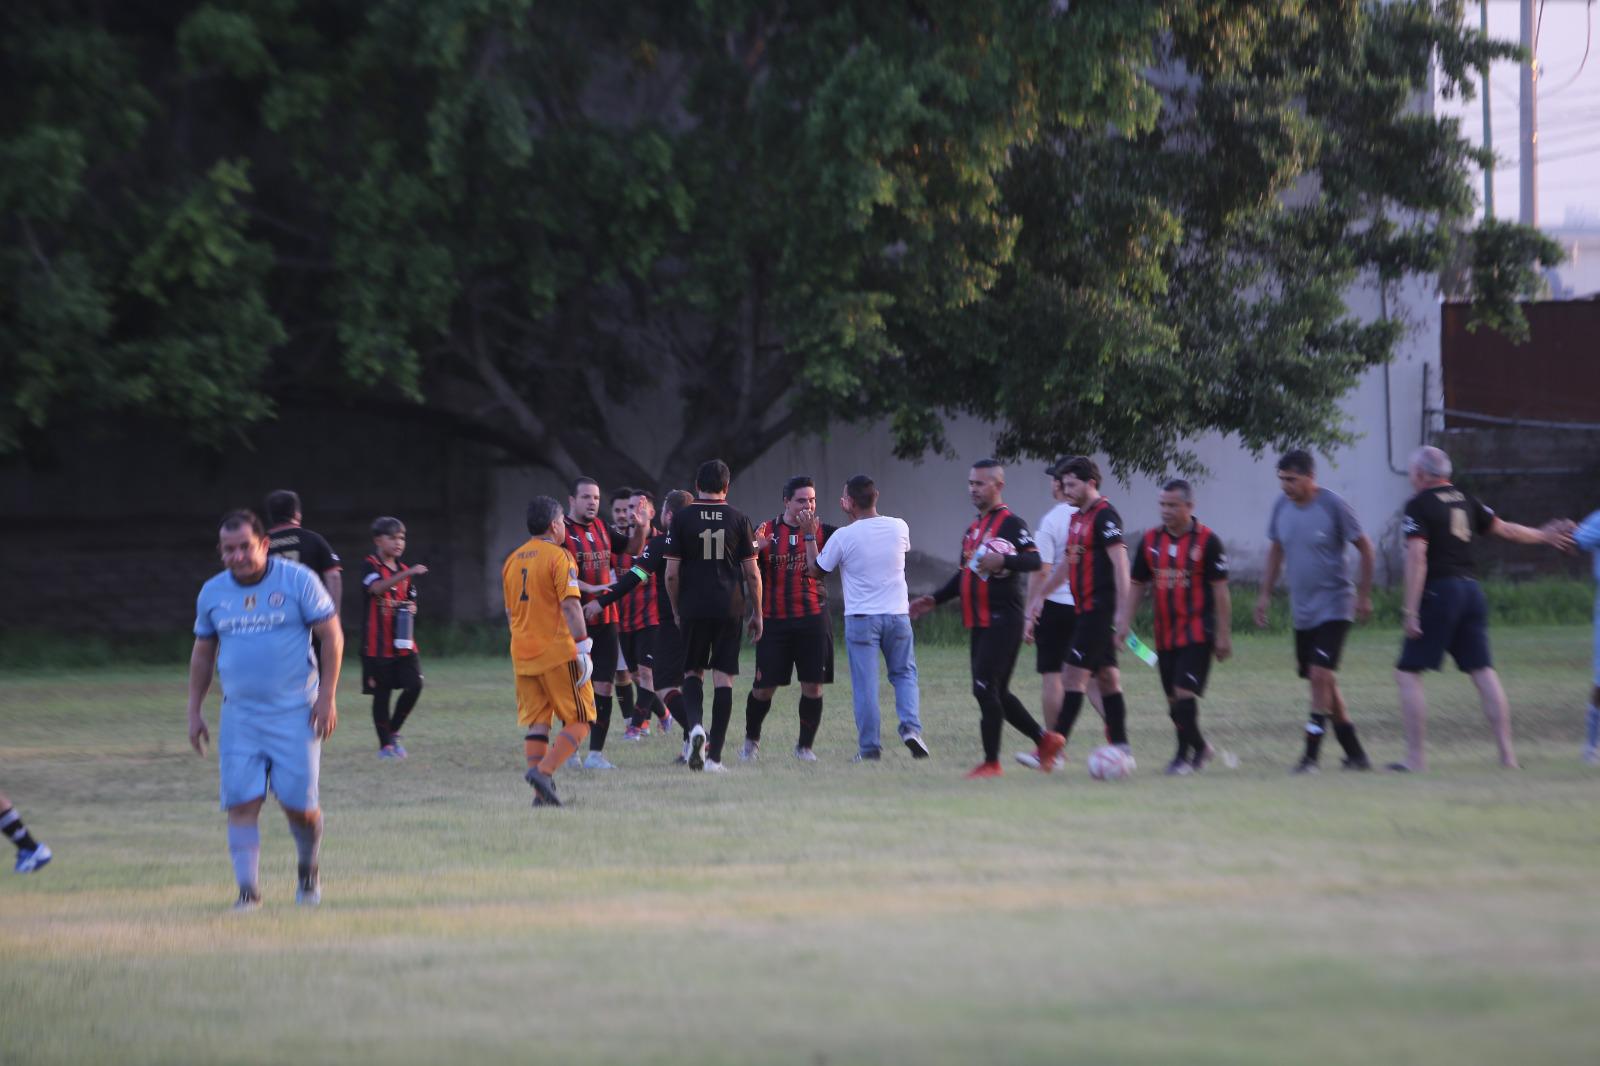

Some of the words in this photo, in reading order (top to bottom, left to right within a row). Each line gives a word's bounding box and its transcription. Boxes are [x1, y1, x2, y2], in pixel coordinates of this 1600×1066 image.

[700, 510, 723, 521] ILIE
[699, 528, 725, 560] 11
[520, 568, 529, 602] 1
